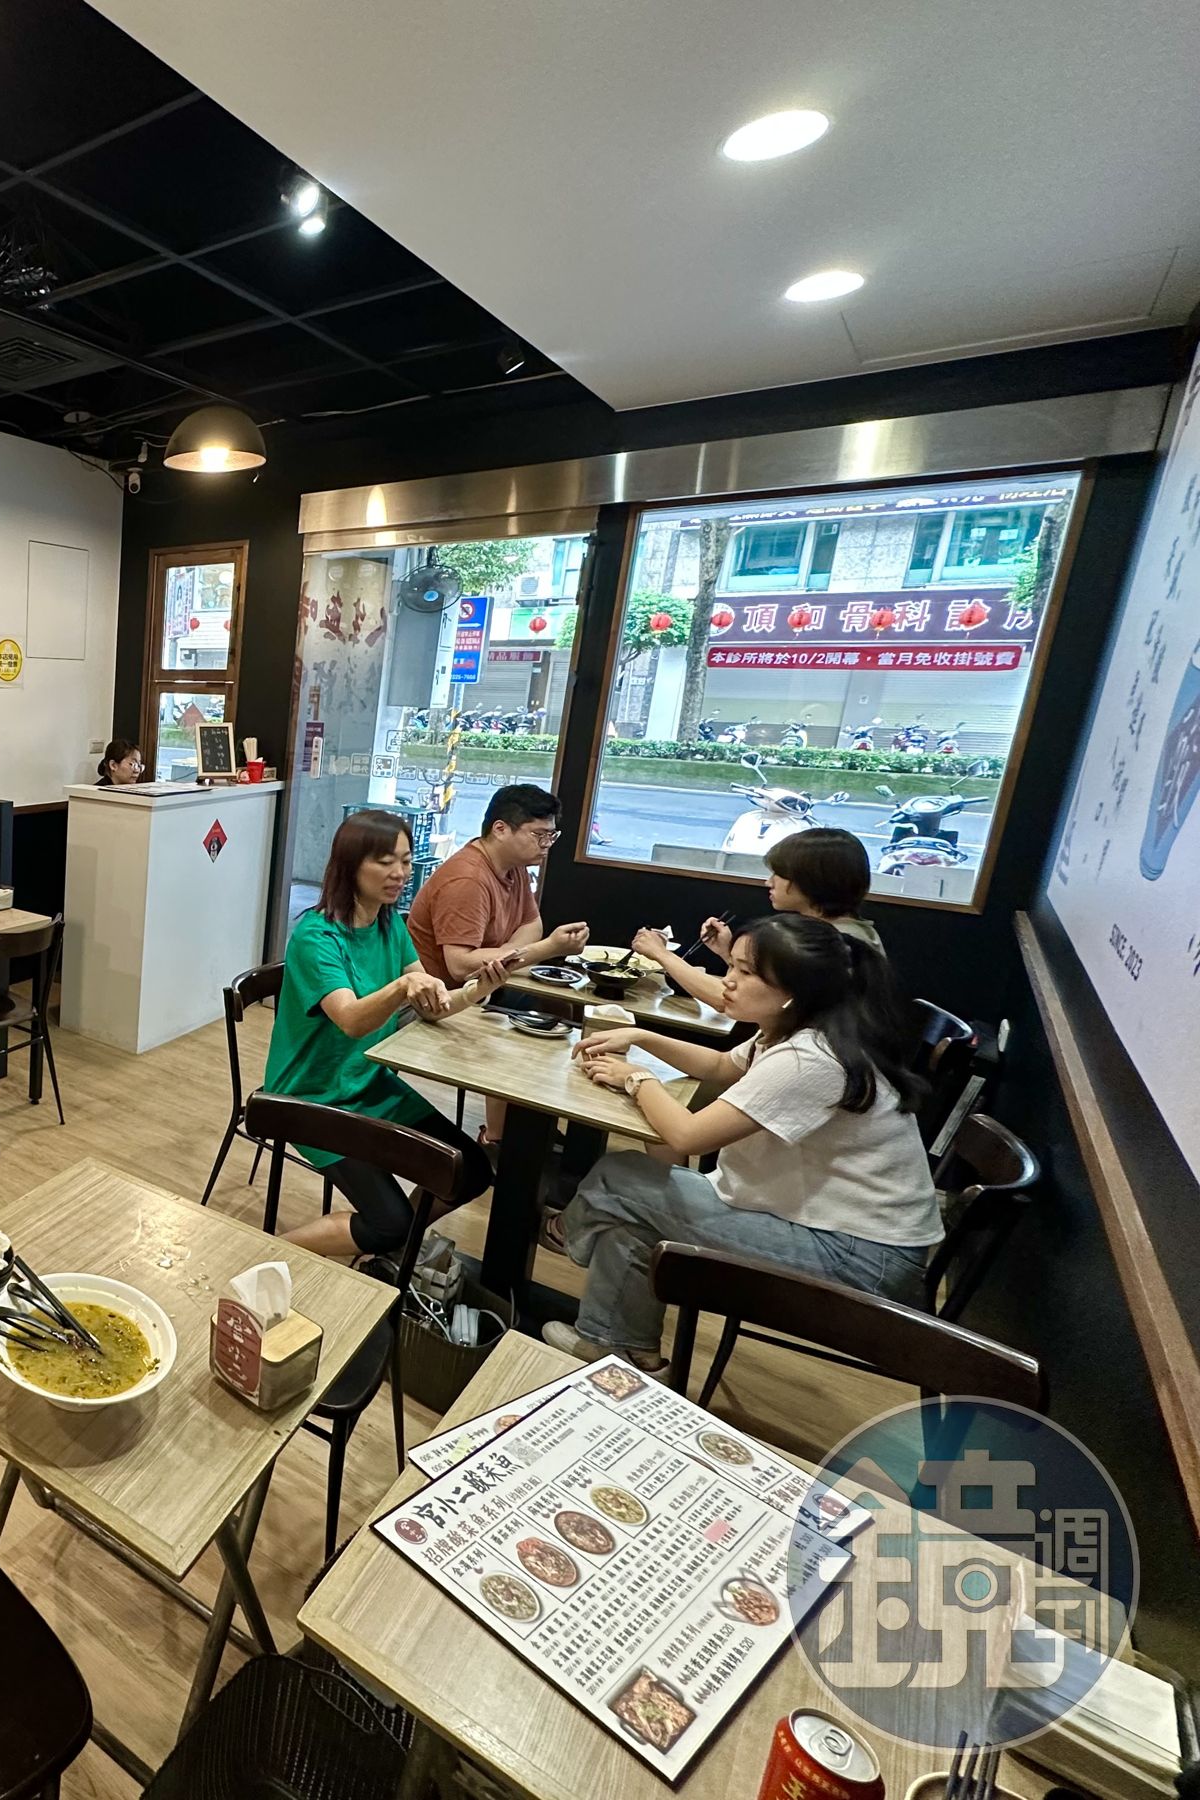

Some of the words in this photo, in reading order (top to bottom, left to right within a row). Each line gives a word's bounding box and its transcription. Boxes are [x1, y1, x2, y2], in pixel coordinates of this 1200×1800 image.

[413, 1452, 523, 1530] 官小二酸菜魚
[524, 1489, 560, 1517] 麻辣系列
[418, 1493, 514, 1567] 招牌酸菜魚系列
[488, 1516, 525, 1546] 番茄系列
[449, 1547, 488, 1578] 金湯系列
